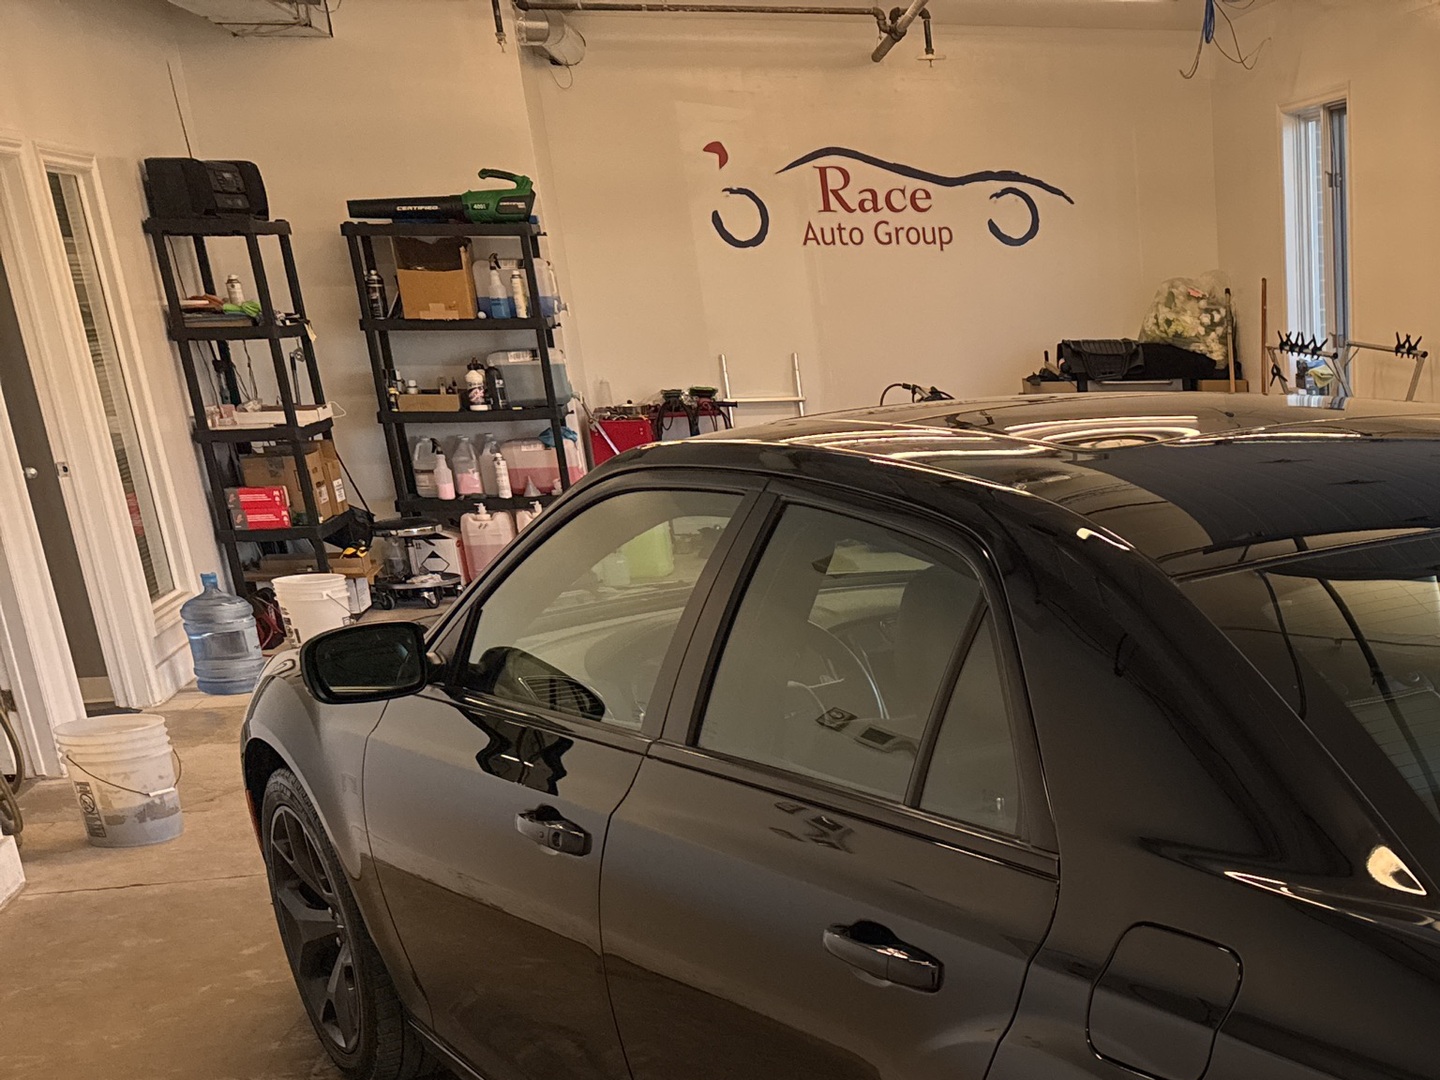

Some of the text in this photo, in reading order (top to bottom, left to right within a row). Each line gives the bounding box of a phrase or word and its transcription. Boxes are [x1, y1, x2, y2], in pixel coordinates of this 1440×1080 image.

[812, 165, 933, 214] Race
[802, 220, 954, 252] Auto Group
